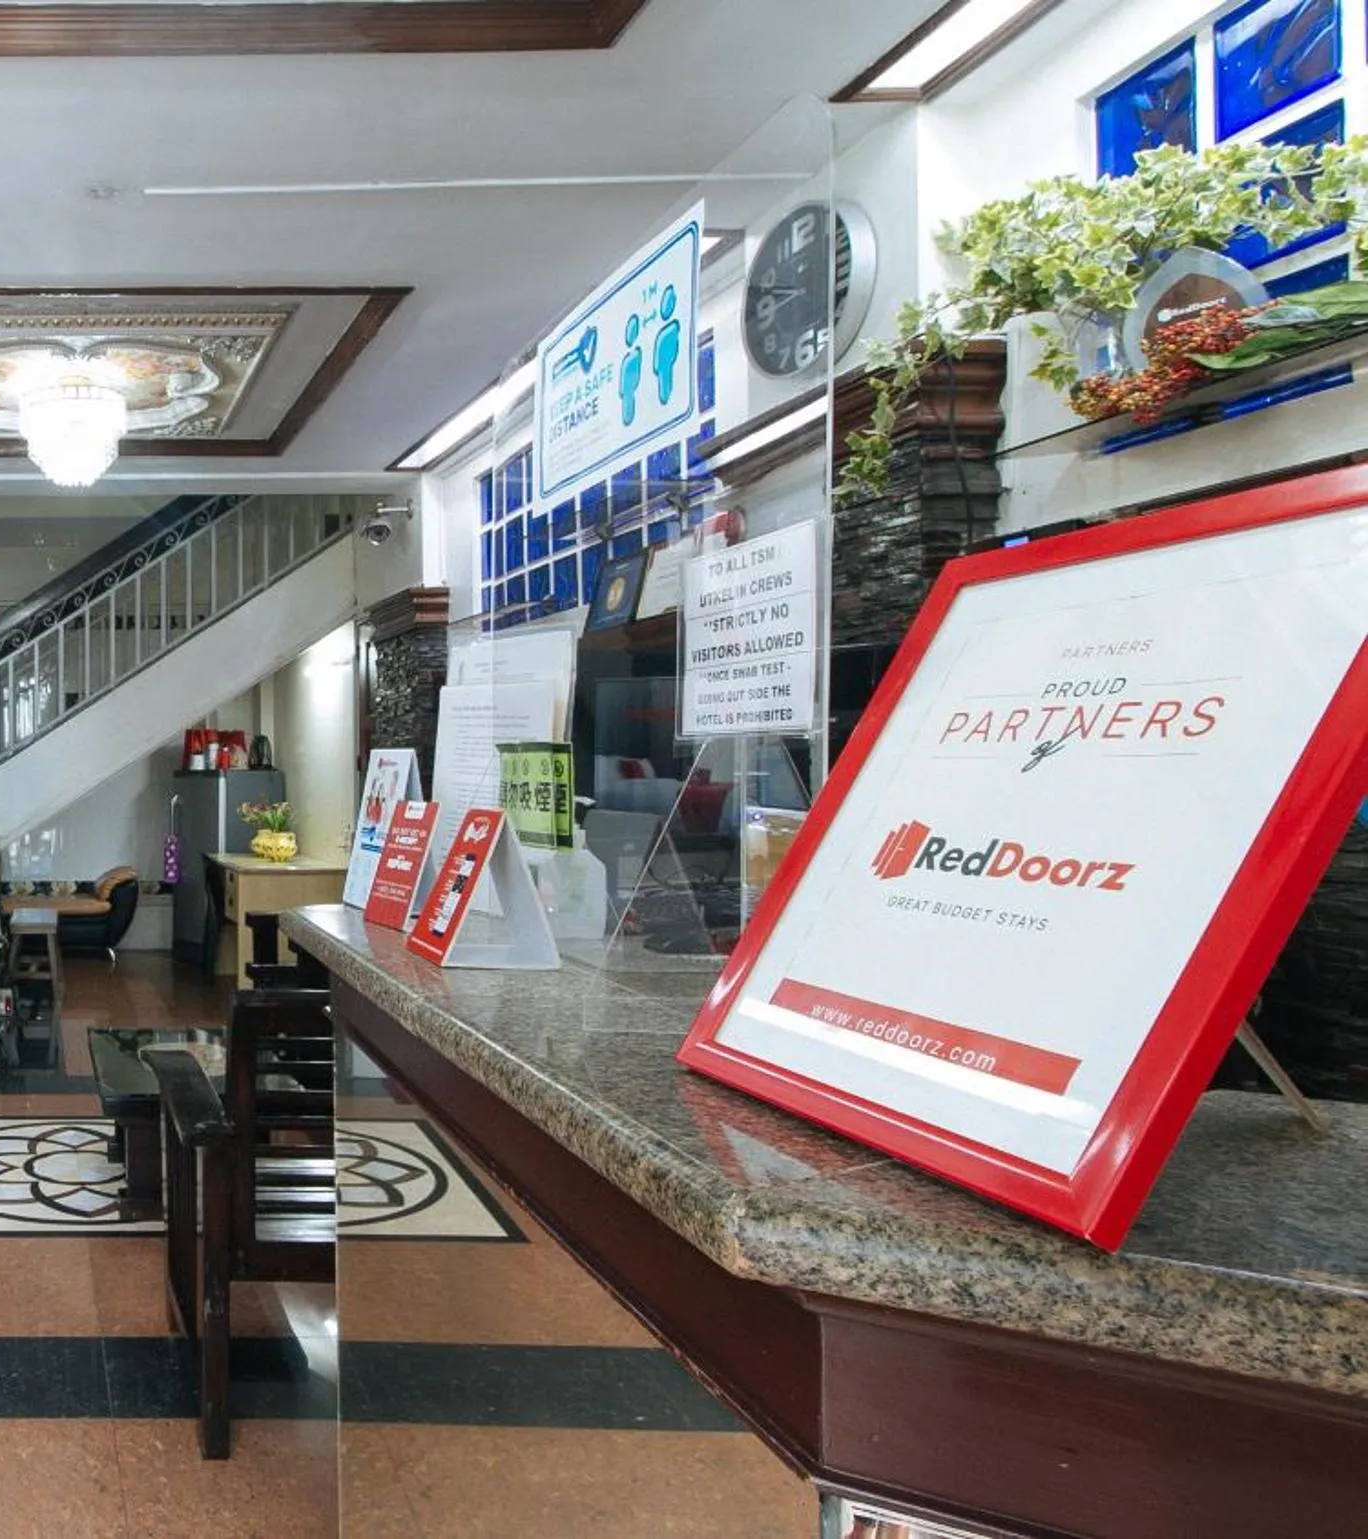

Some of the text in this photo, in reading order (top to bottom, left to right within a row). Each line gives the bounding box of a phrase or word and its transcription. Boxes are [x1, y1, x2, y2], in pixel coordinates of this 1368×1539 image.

[585, 364, 614, 397] SAFE
[549, 396, 599, 443] DISTANCE
[708, 561, 723, 579] TO
[727, 555, 748, 573] ALL
[750, 570, 793, 595] CREWS
[771, 603, 790, 621] NO
[692, 631, 804, 664] VISITORS ALLOWED
[760, 661, 786, 676] TEST
[771, 683, 792, 698] THE
[1041, 676, 1127, 699] PROUD
[939, 696, 1226, 745] PARTNERS
[914, 836, 1136, 892] RedDoorz
[887, 894, 1049, 932] GREAT BUDGET STAYS
[810, 1003, 997, 1073] www.reddoorz.com
